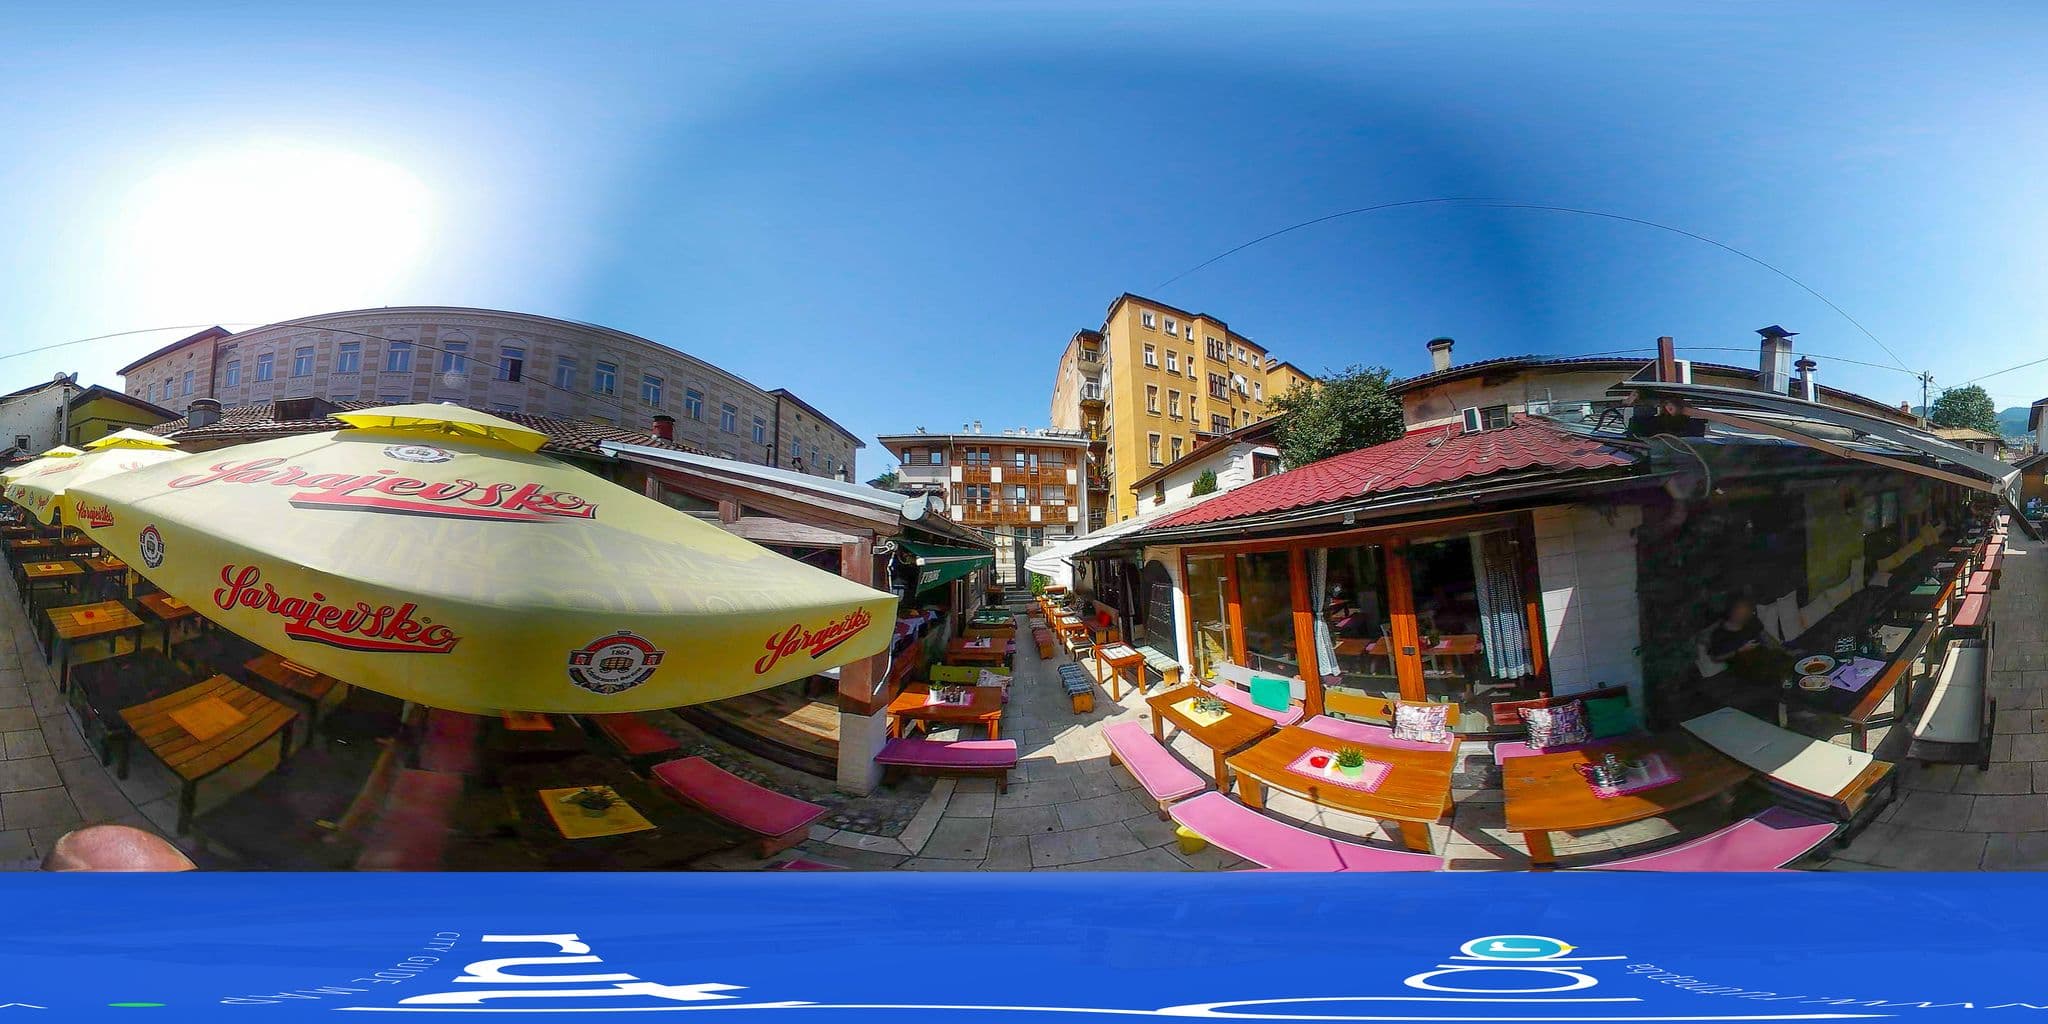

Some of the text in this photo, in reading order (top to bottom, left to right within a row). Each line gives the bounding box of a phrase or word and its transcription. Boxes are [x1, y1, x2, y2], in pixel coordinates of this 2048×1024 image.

[168, 457, 597, 523] Sarajevsko
[213, 564, 464, 653] Sarajevsko
[754, 606, 872, 675] Sarajevsko
